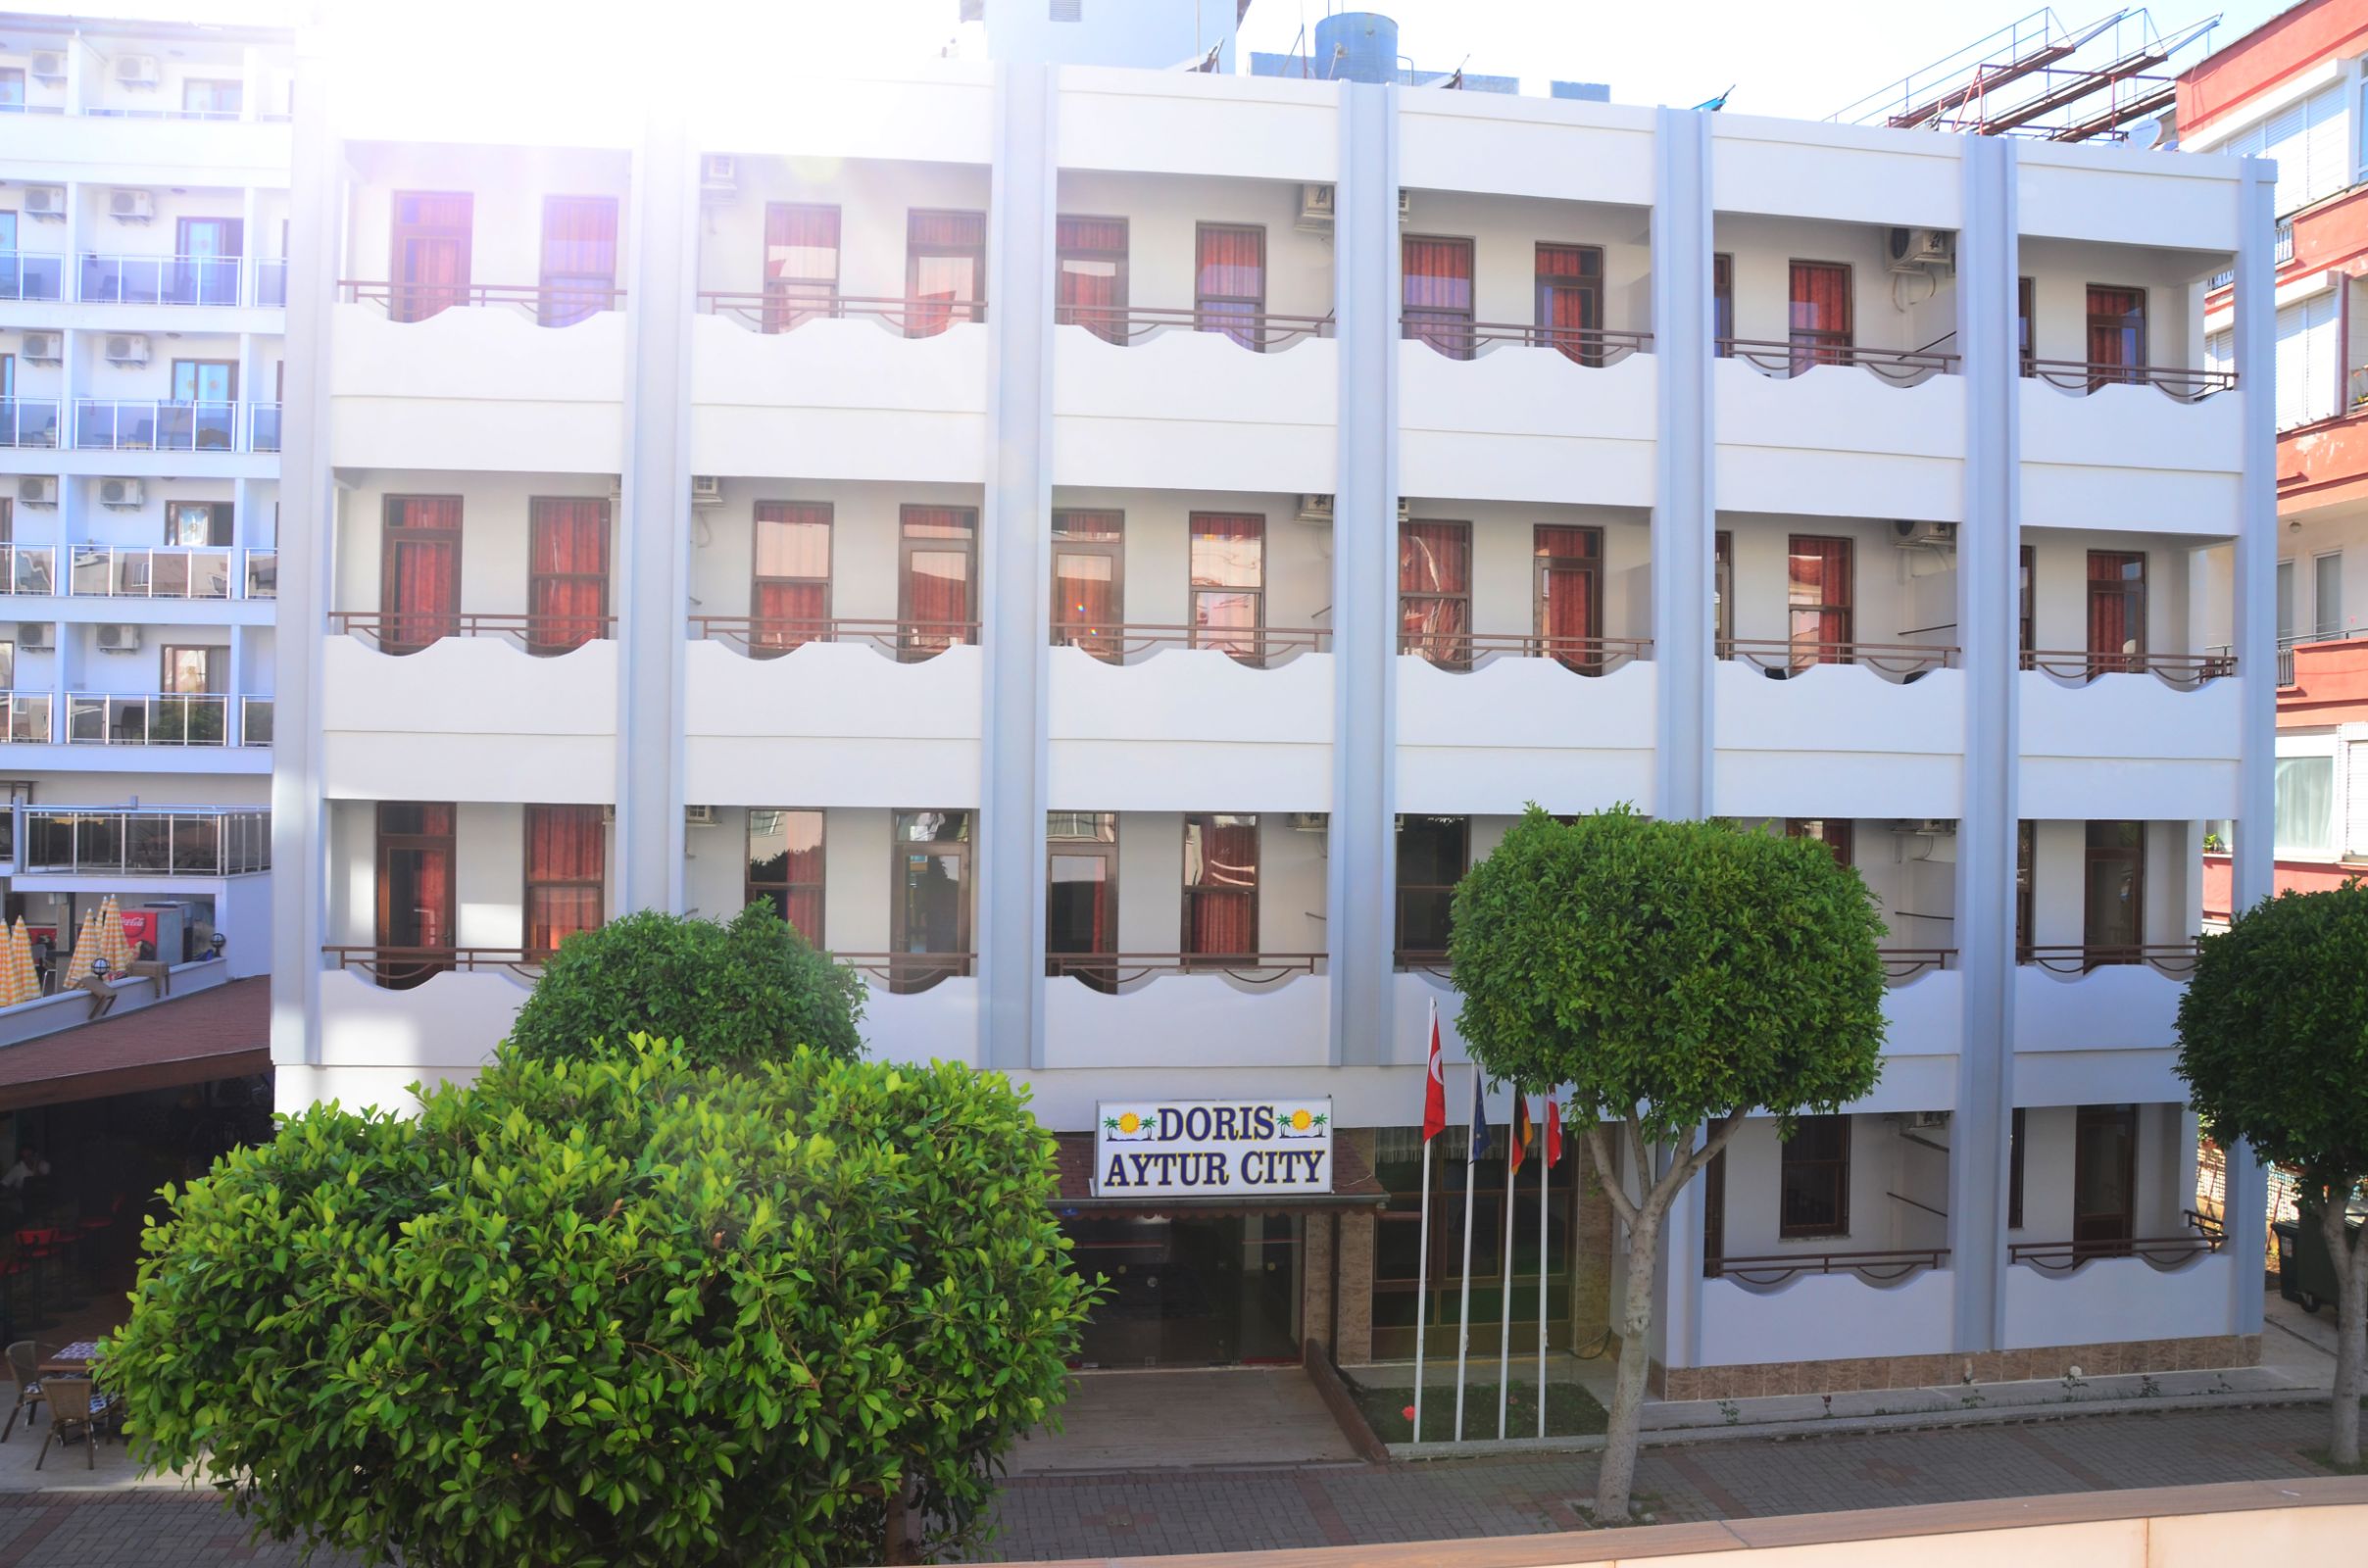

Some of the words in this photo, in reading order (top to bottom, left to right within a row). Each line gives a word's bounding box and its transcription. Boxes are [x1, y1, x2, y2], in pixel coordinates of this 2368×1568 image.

[1158, 1105, 1274, 1142] DORIS
[1104, 1152, 1229, 1187] AYTUR
[1241, 1151, 1325, 1185] CITY
